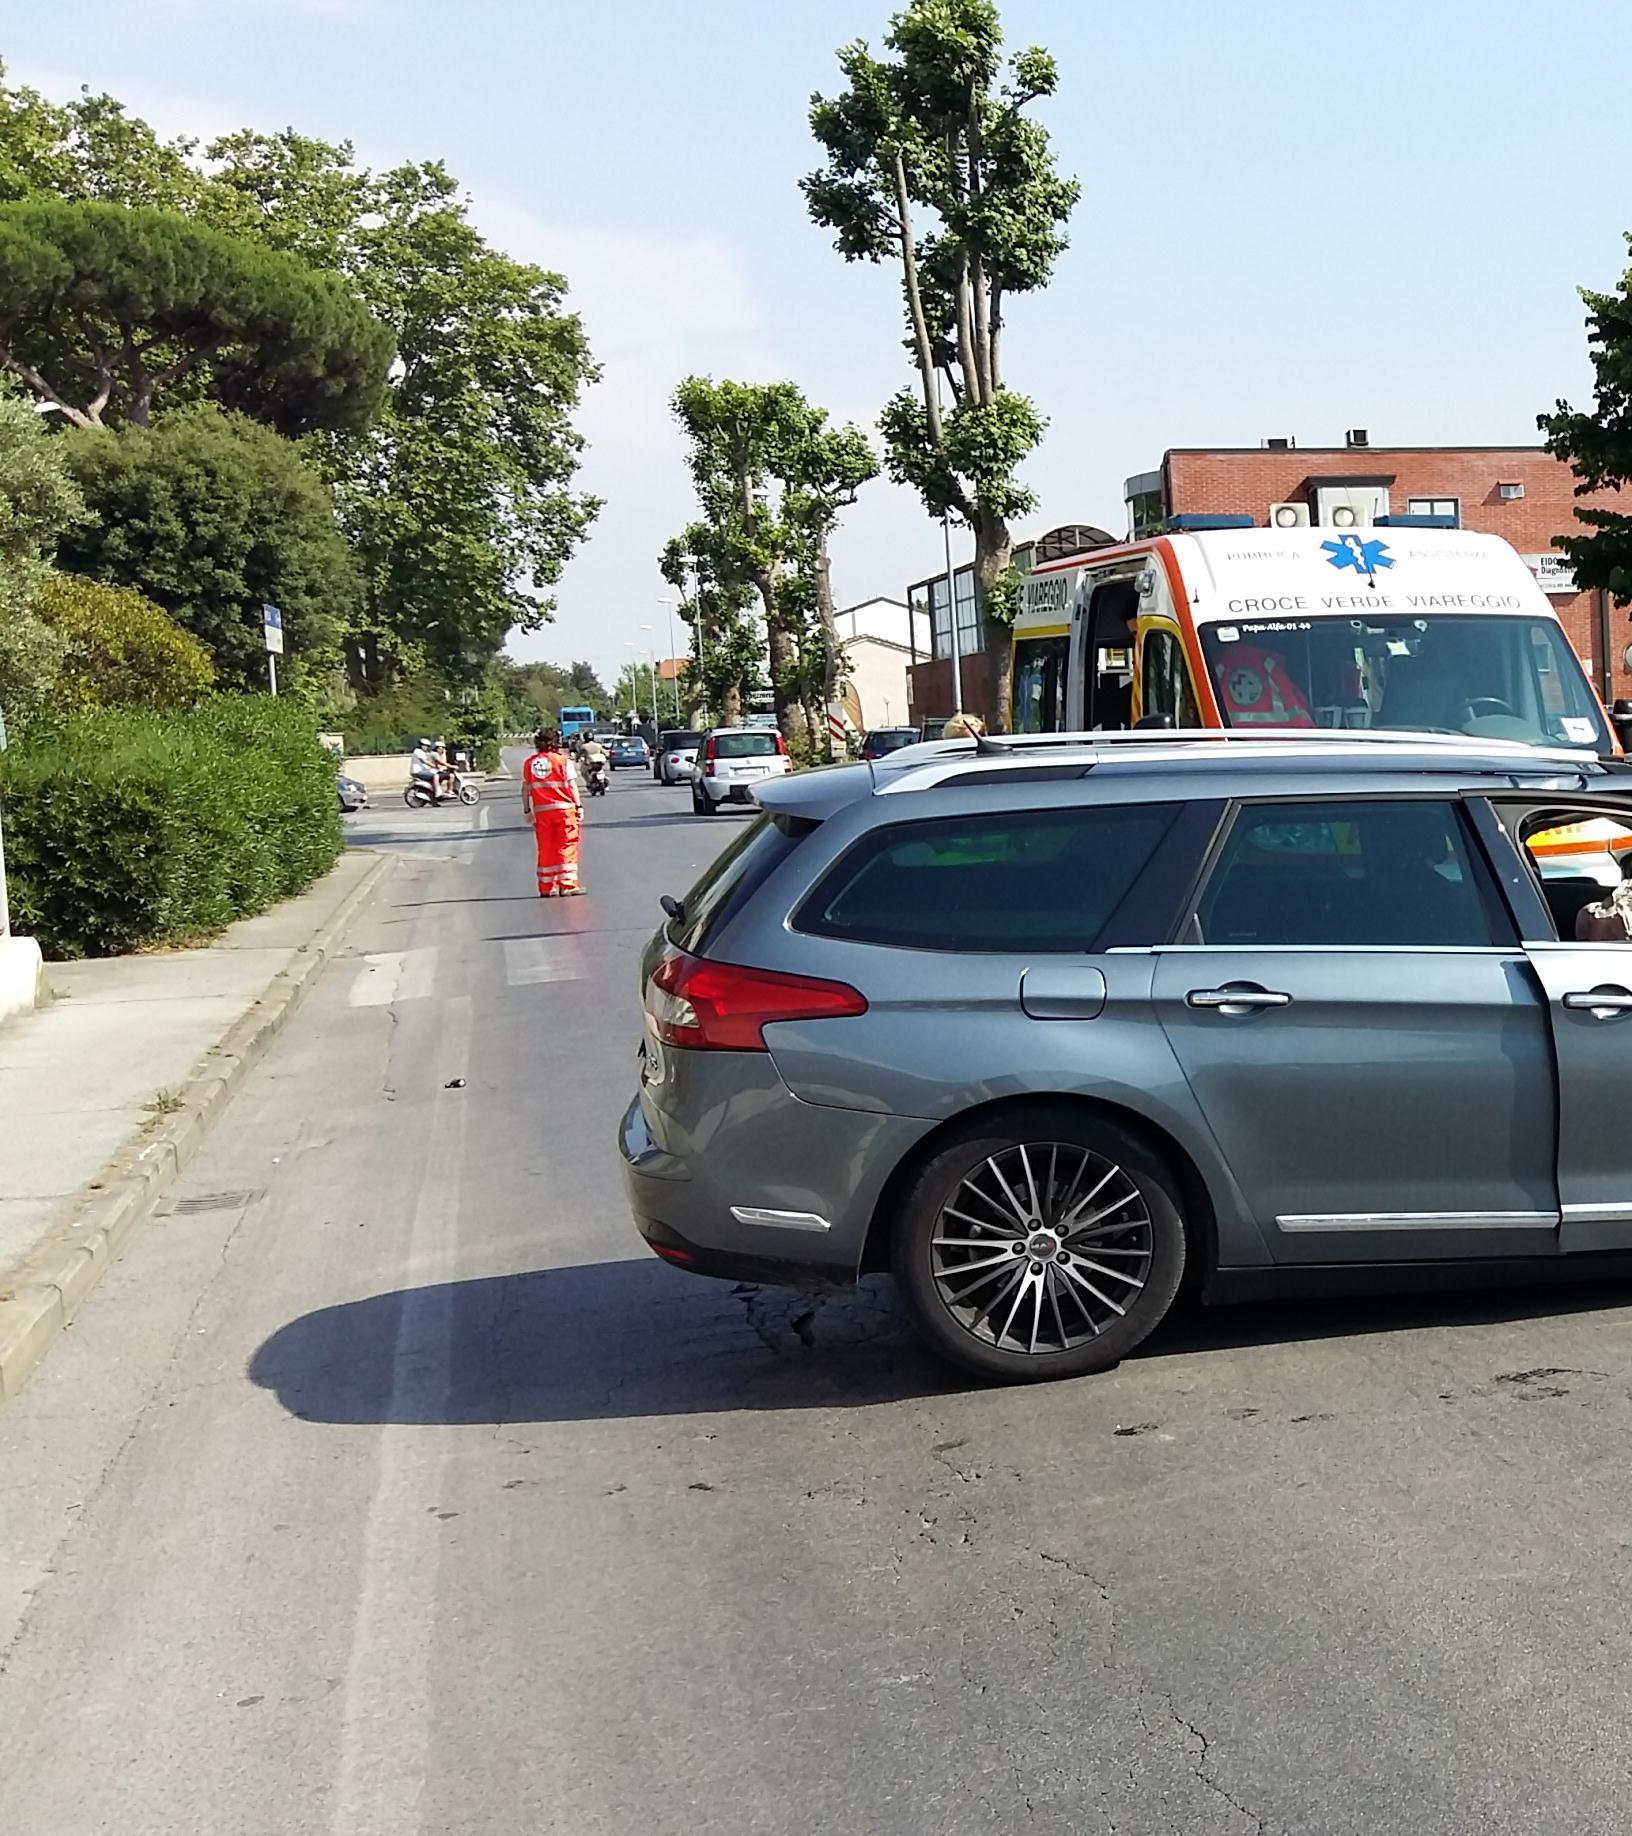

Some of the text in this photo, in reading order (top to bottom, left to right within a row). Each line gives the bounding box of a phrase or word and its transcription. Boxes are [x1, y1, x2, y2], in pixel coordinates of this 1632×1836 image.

[1028, 577, 1068, 614] VIAREGGIO
[1227, 594, 1522, 613] CROCE VERDE VIAREGGIO
